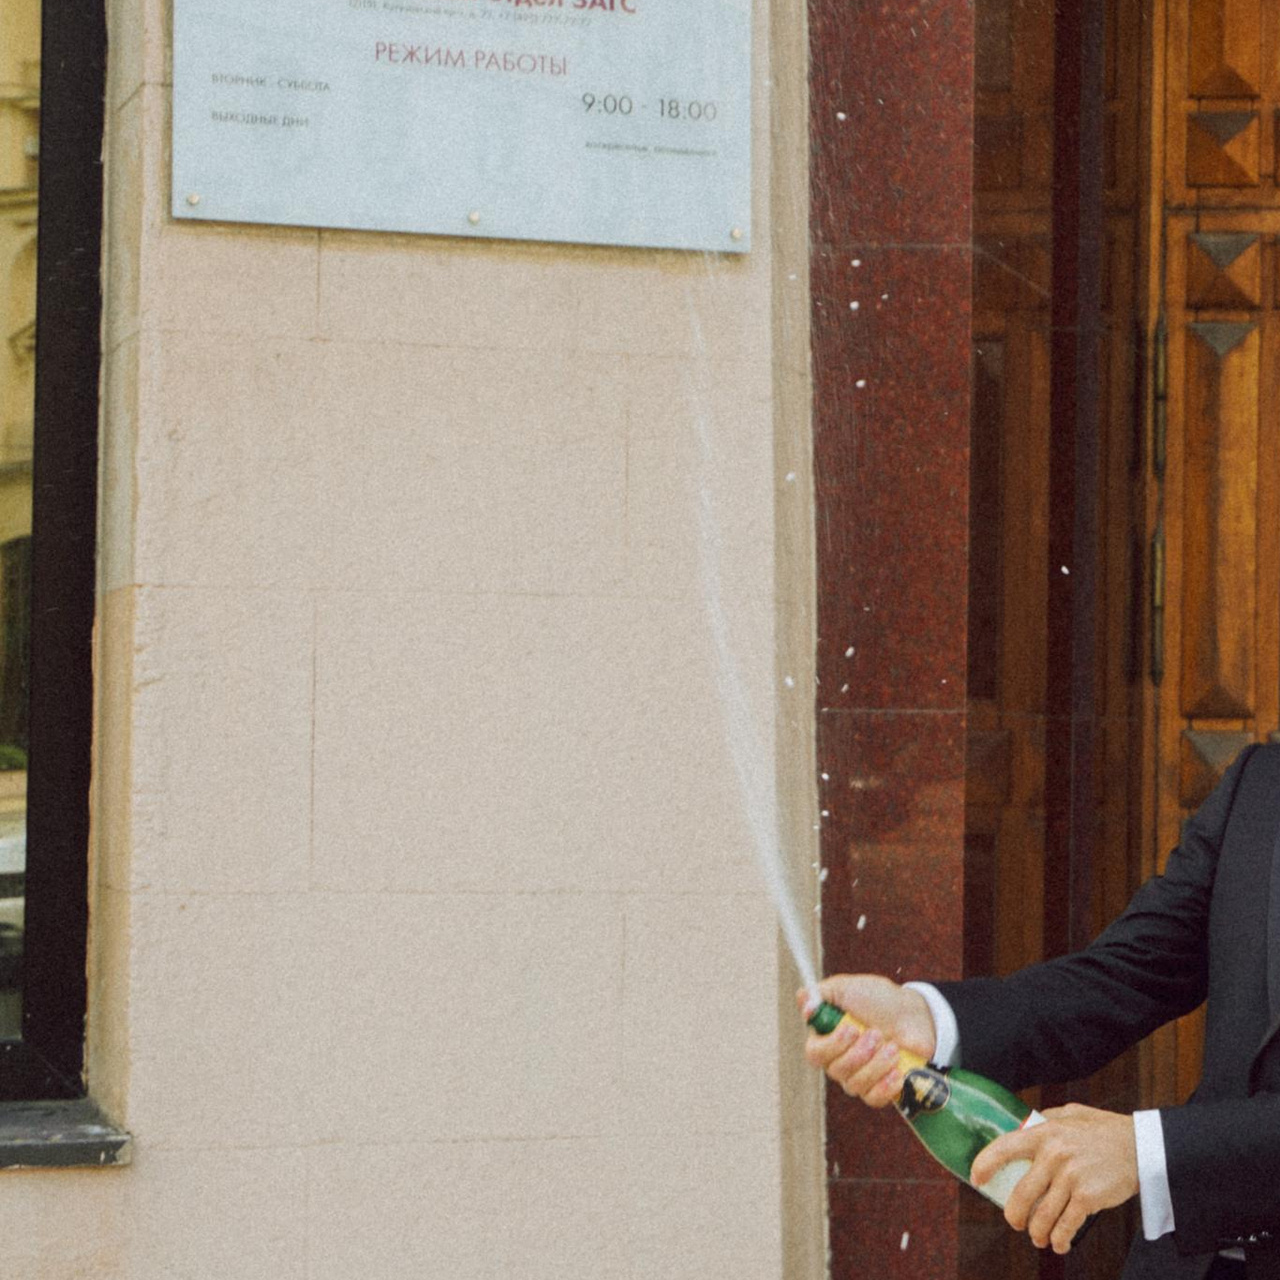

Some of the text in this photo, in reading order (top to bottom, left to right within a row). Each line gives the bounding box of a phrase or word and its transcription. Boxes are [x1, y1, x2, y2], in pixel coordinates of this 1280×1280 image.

[374, 41, 568, 76] РЕЖИМ РАБОТЫ
[582, 92, 633, 115] 9:00
[660, 98, 717, 121] 18:00
